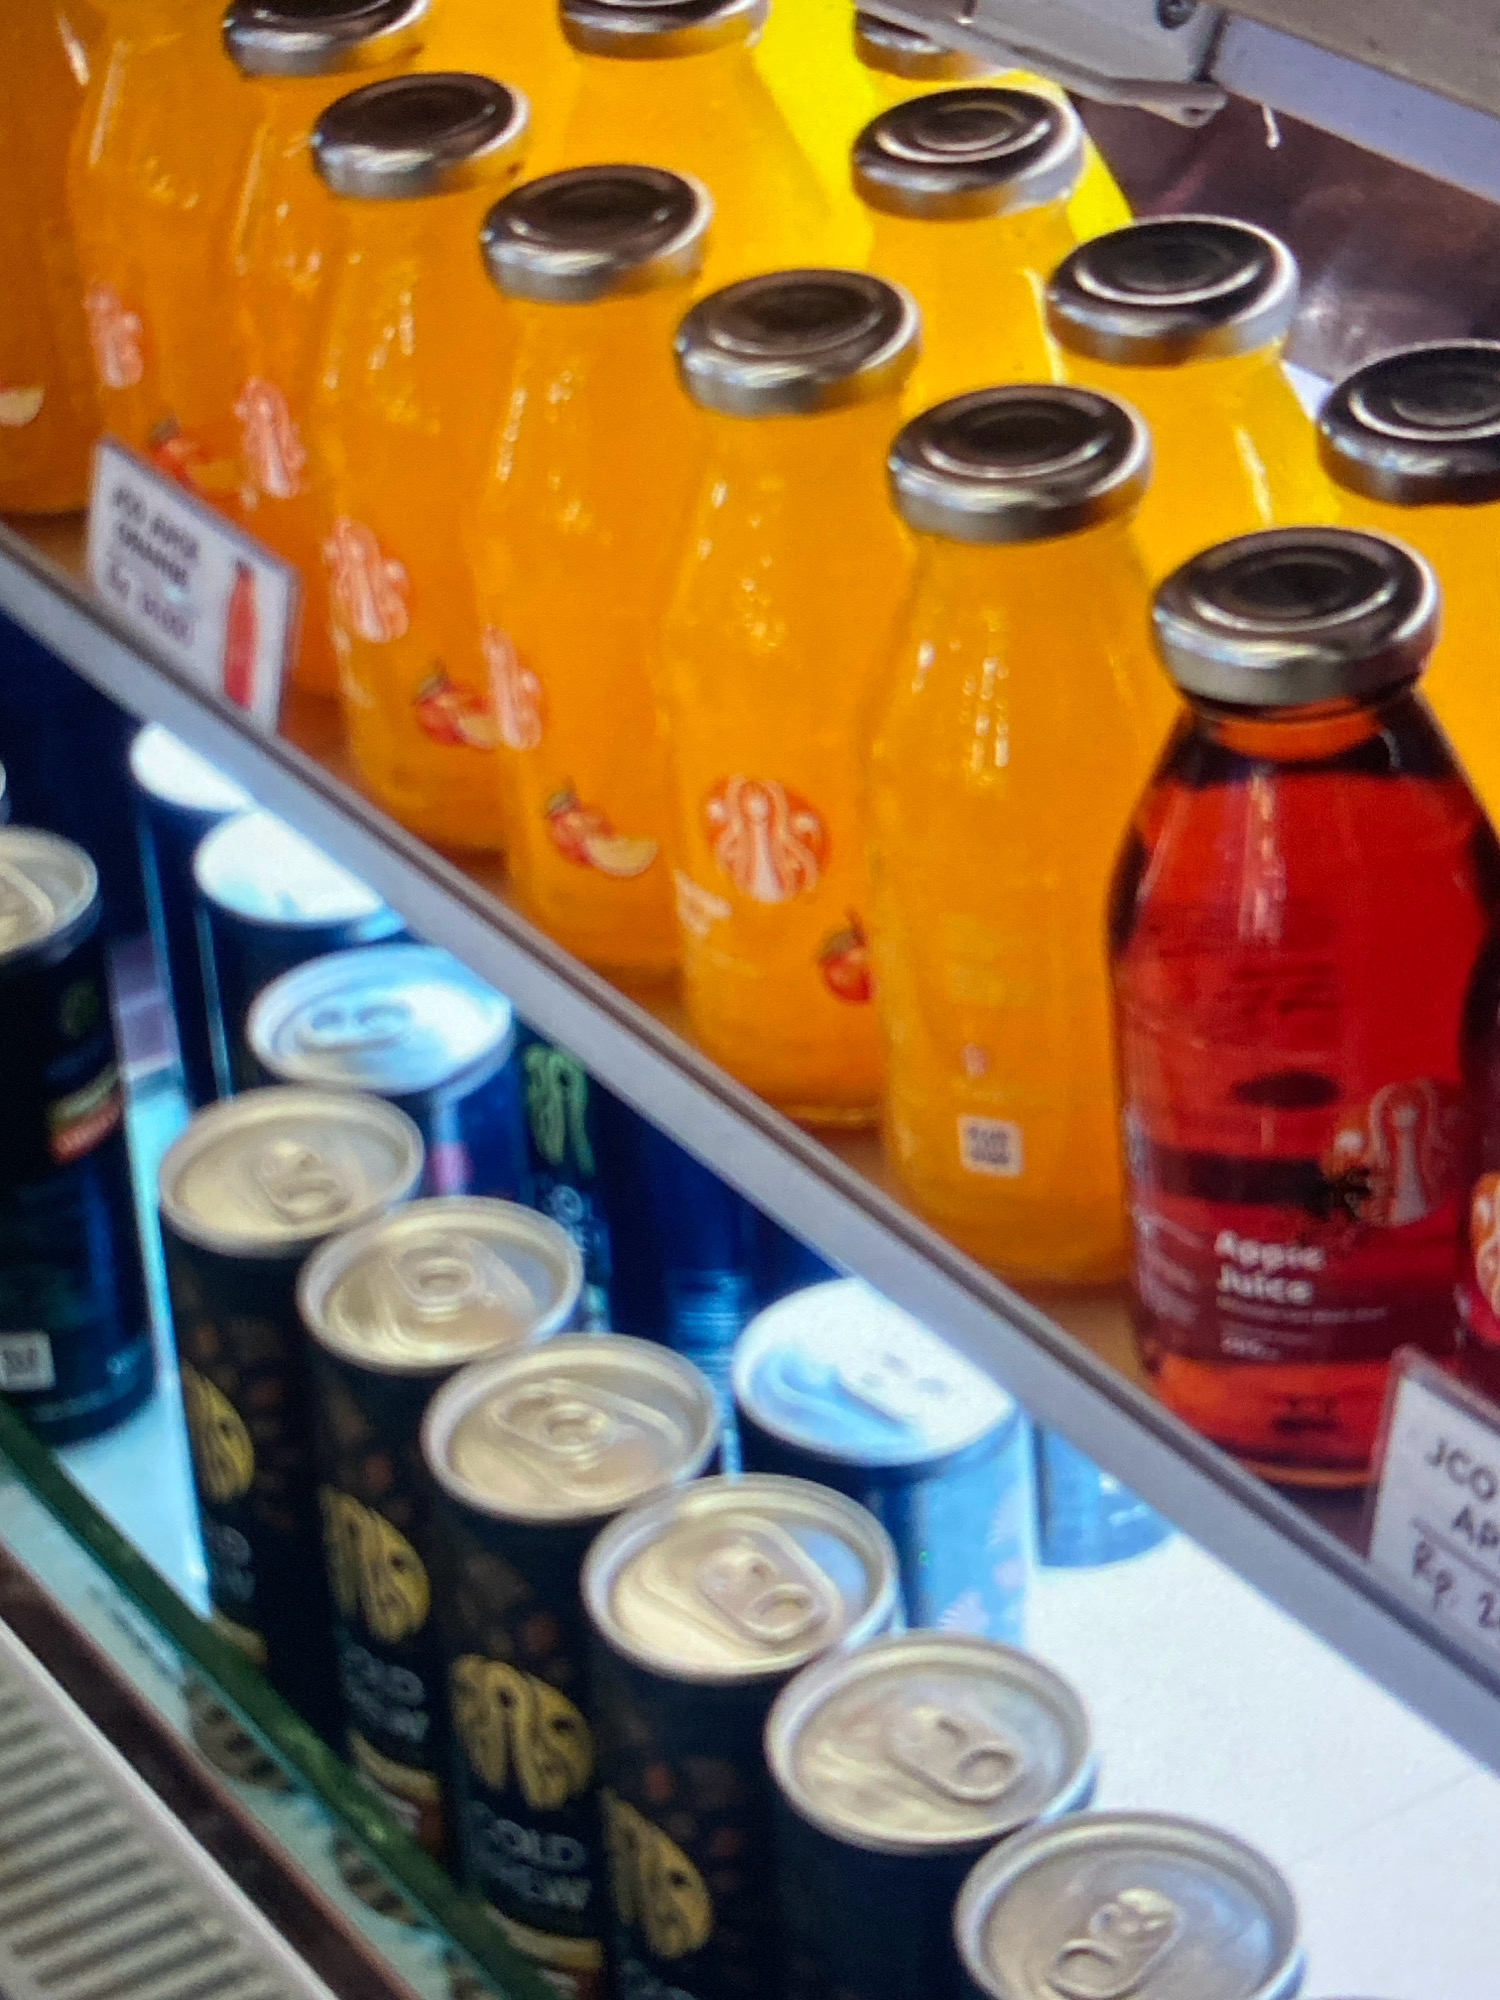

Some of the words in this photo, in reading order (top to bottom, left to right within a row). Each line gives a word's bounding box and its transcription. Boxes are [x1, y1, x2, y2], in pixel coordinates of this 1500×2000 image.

[1214, 1230, 1325, 1271] Apple
[1216, 1264, 1313, 1305] Juice
[1425, 1437, 1498, 1501] JCO
